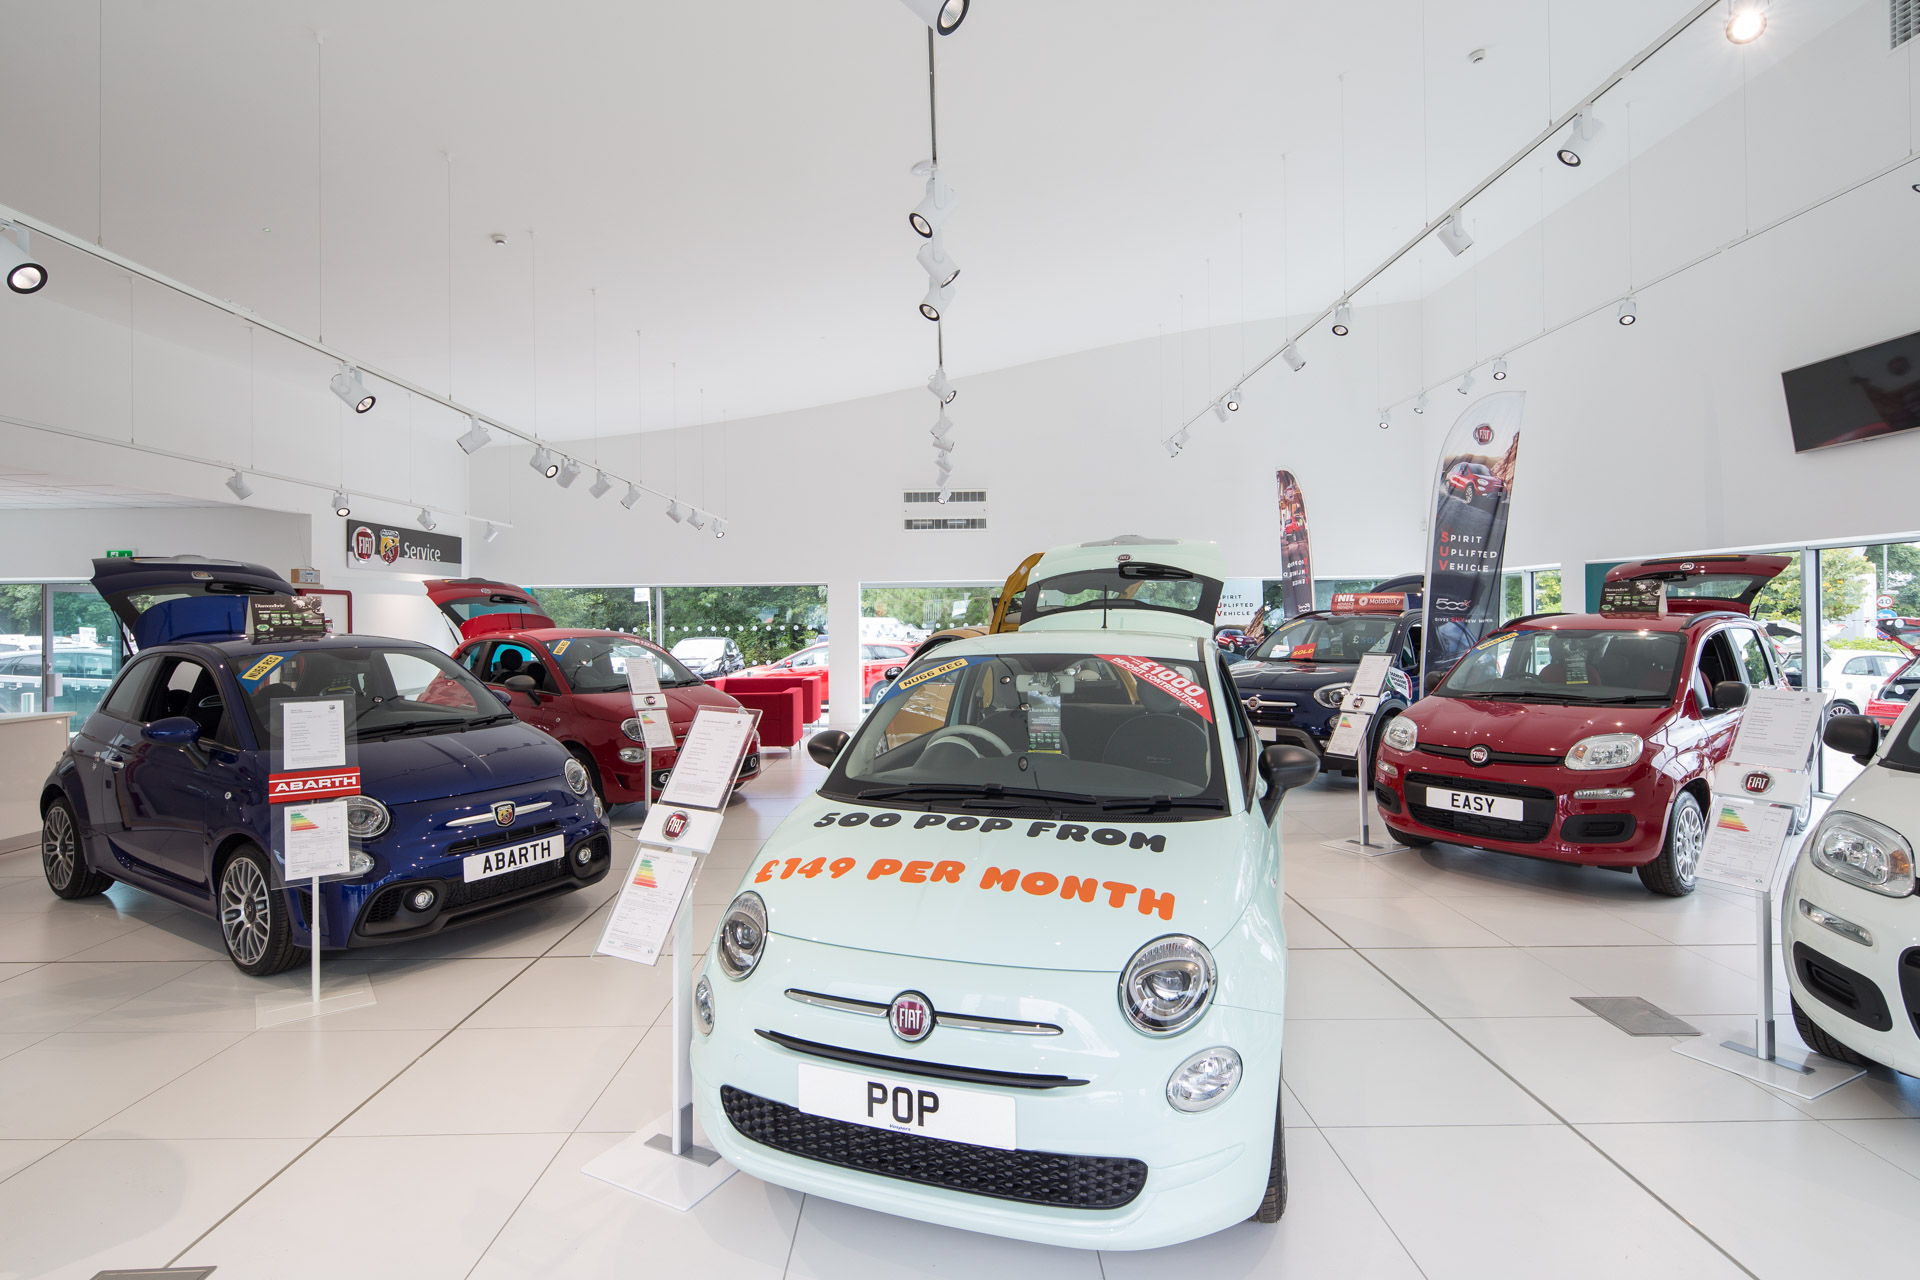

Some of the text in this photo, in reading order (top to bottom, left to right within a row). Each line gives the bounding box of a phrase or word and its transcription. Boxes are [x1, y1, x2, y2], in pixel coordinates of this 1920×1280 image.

[1479, 429, 1490, 440] FIAT
[358, 536, 373, 554] FIAT
[1440, 531, 1482, 544] SPIRIT
[404, 542, 441, 561] Service
[1439, 545, 1498, 559] UPLIFTED
[1439, 559, 1489, 572] VEHICLE
[1337, 594, 1355, 602] NIL
[1361, 636, 1386, 645] SOLD
[1292, 648, 1315, 656] SOLD
[903, 660, 963, 687] NU66 REG
[1139, 661, 1205, 697] £1000
[1111, 657, 1204, 709] DEPOSIT CONTRIBUTION
[275, 776, 356, 792] ABARTH
[1747, 776, 1769, 789] FIAT
[1451, 793, 1495, 813] EASY
[666, 816, 685, 833] FIAT
[813, 812, 1167, 853] 500 POP FROM
[482, 840, 551, 874] ABARTH
[754, 857, 1176, 921] £149 PER MONTH
[898, 1006, 924, 1030] FIAT
[867, 1081, 940, 1127] POP
